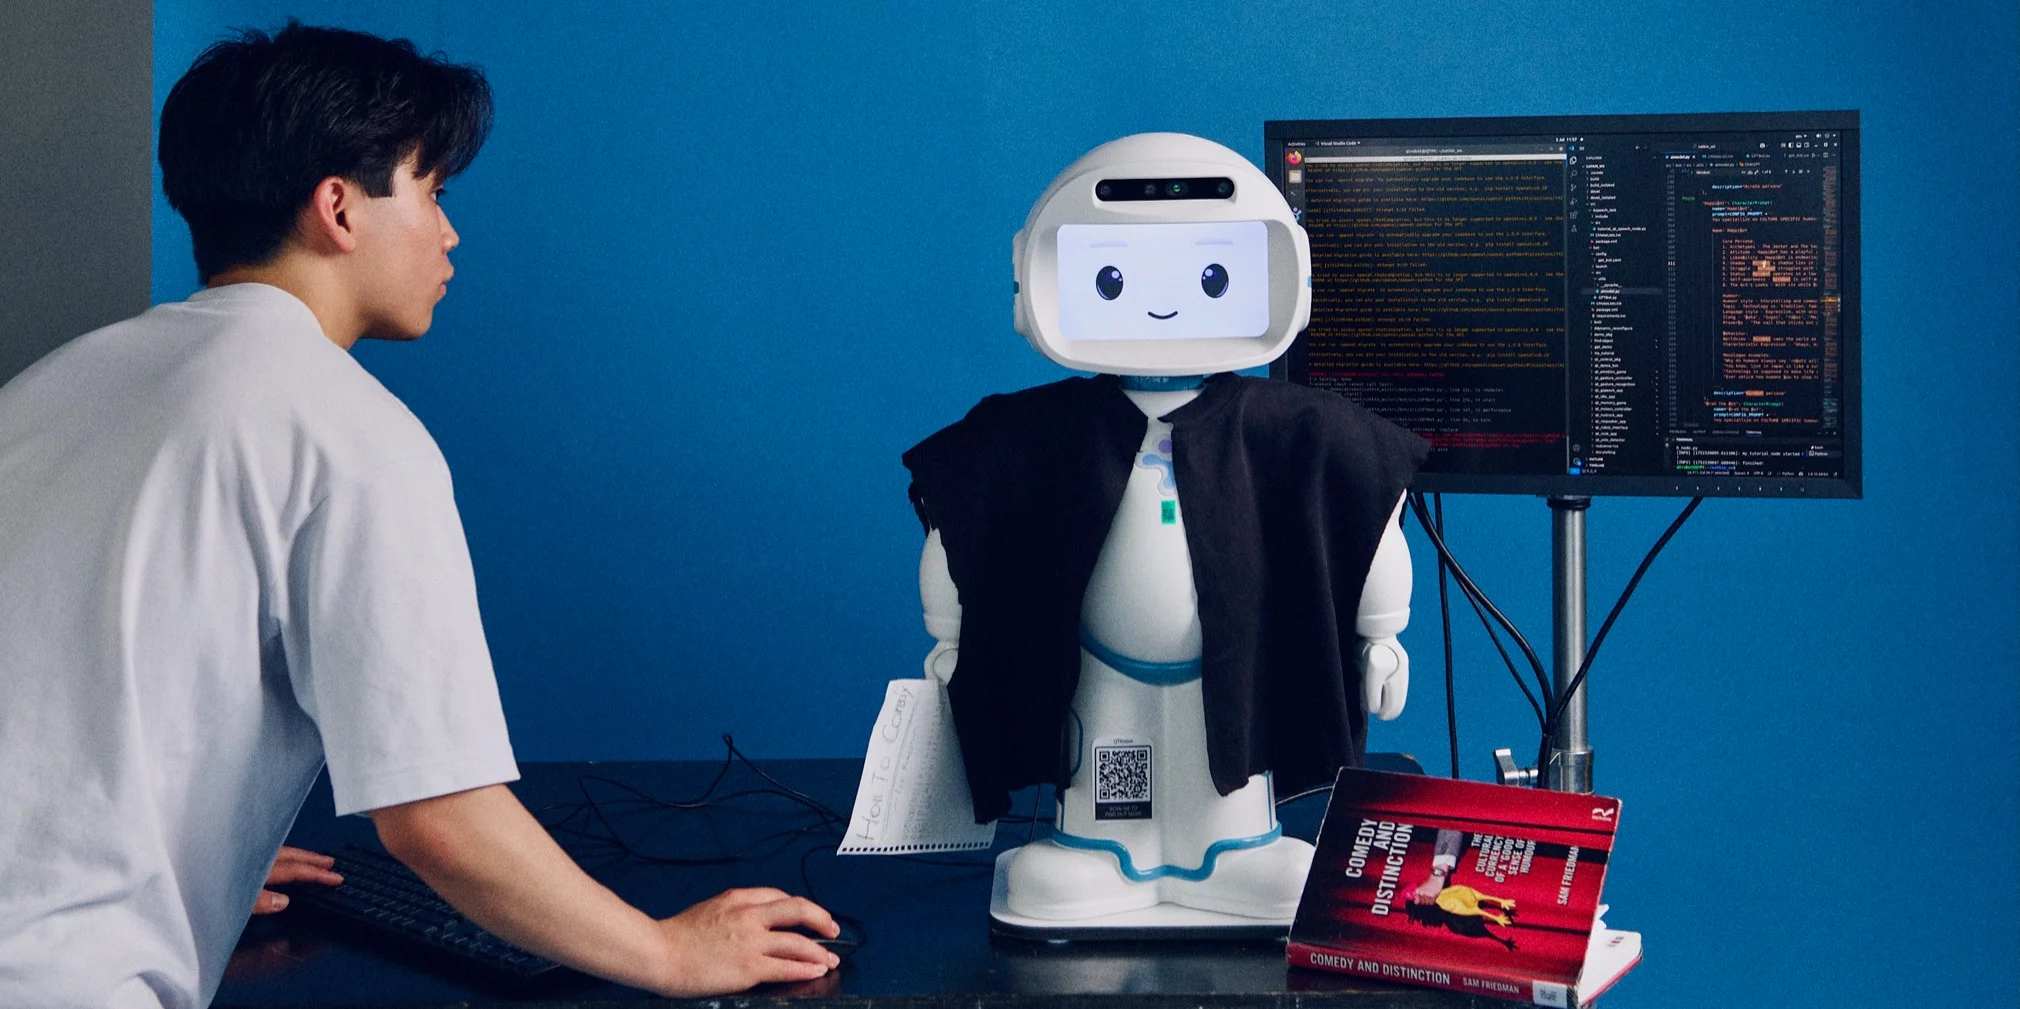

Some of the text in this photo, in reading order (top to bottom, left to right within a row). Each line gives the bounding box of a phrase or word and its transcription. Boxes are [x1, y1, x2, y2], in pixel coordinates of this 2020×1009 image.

[872, 757, 891, 785] To
[1592, 808, 1614, 821] R
[1345, 819, 1377, 878] COMEDY
[1373, 821, 1395, 850] AND
[1471, 833, 1483, 847] THE
[1371, 823, 1413, 915] DISTINCTION
[1475, 835, 1493, 872] CULTURAL
[1485, 835, 1504, 877] CURRENCY
[1508, 838, 1526, 875] SENSE OF
[1519, 840, 1536, 873] HUMOUR
[1494, 871, 1505, 883] OF
[1557, 887, 1570, 905] SAM
[1310, 953, 1519, 994] COMEDY AND DISTINCTION SAM FRIEDMAN
